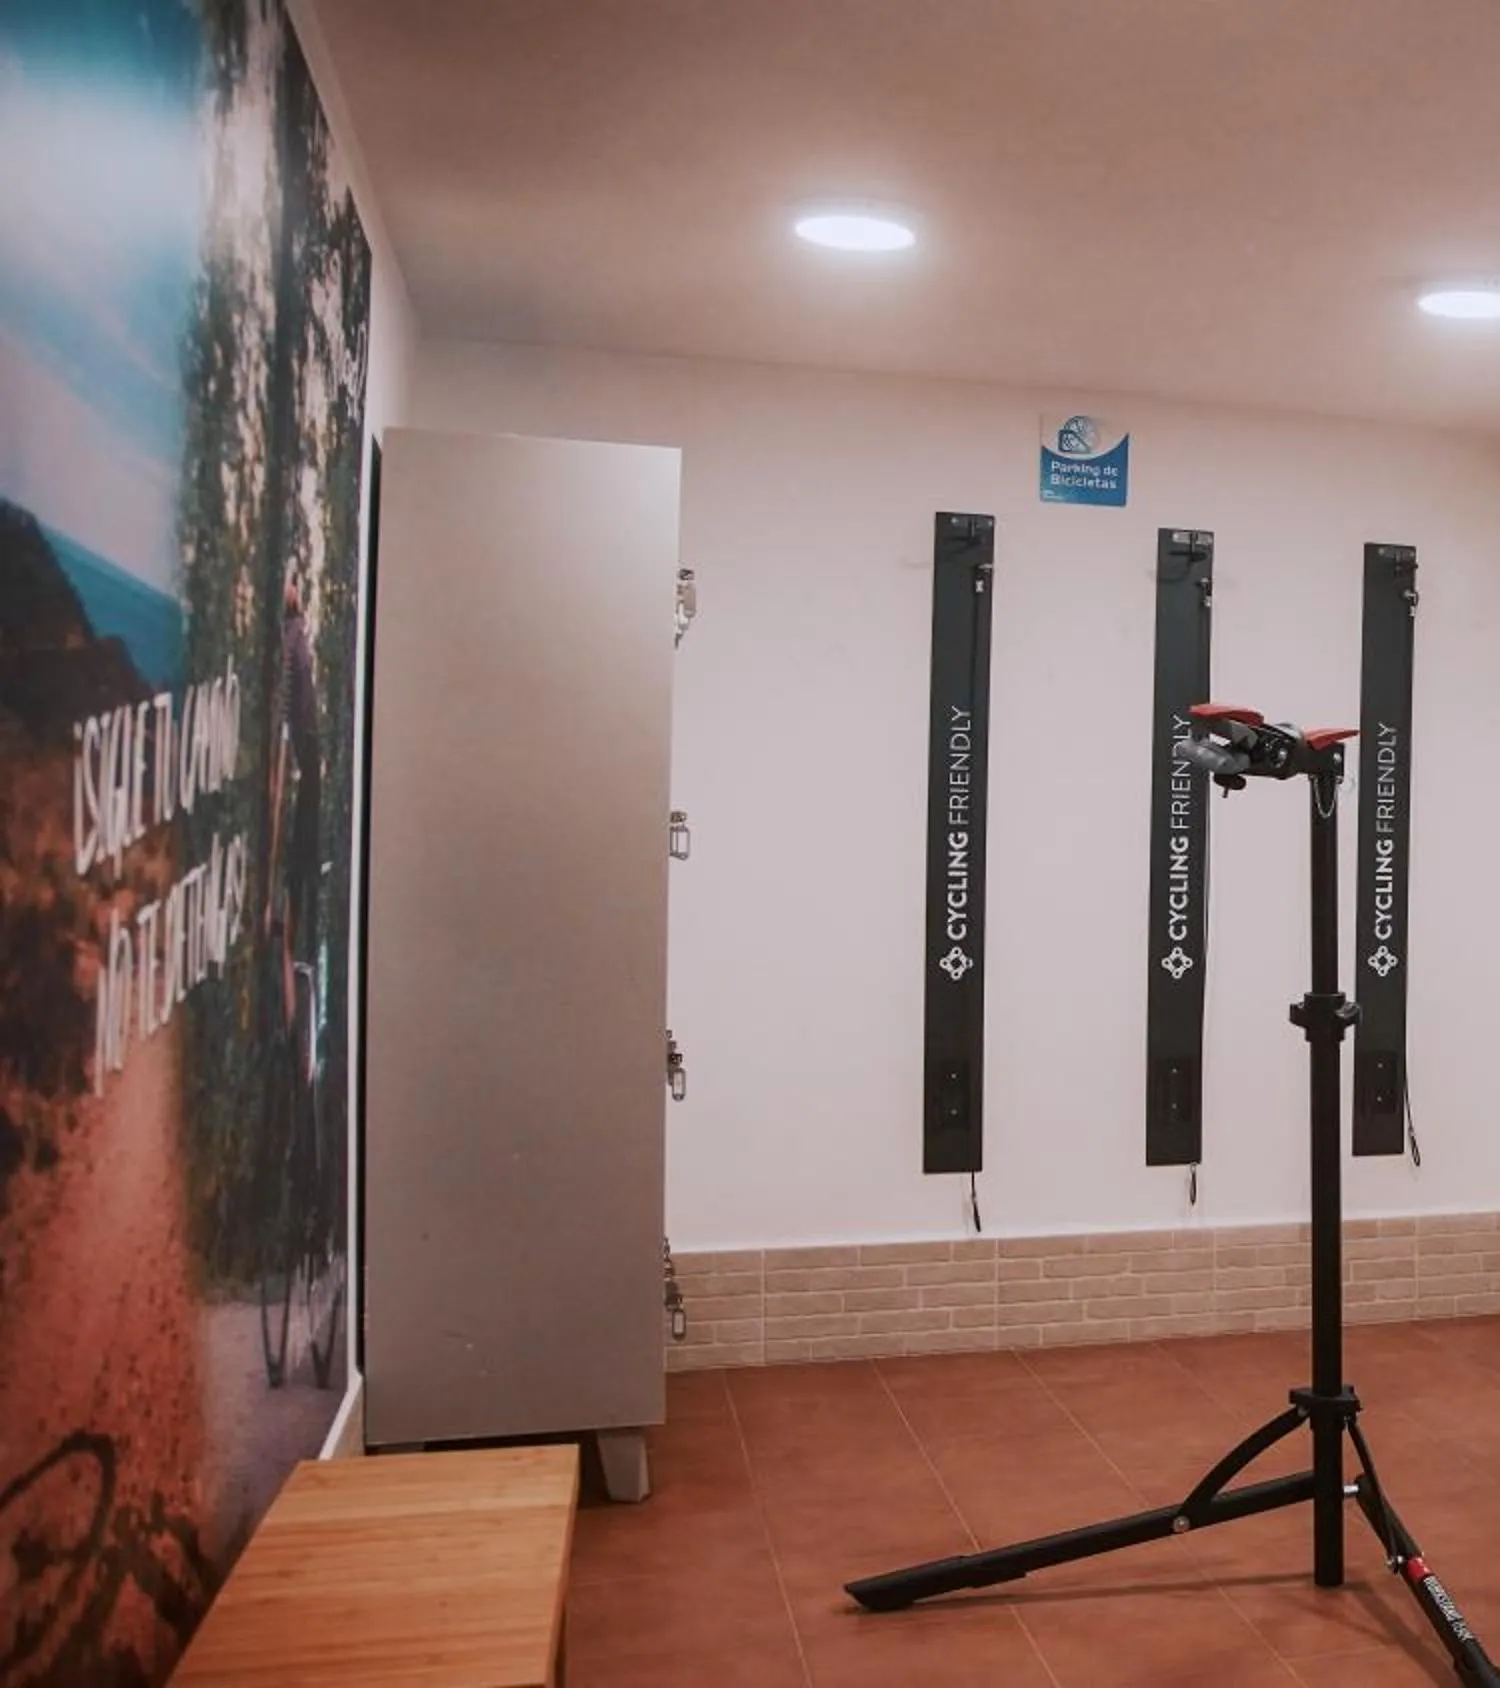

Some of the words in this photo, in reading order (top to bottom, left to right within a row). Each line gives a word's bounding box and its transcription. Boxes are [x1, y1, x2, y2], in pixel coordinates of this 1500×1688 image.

[1051, 473, 1117, 489] Bicicletas
[1052, 460, 1101, 477] Parking
[1103, 466, 1118, 477] de
[948, 705, 972, 825] FRIENDLY
[1376, 721, 1398, 833] FRIENDLY
[947, 831, 969, 941] CYCLING
[1169, 836, 1190, 941] CYCLING
[1375, 839, 1394, 941] CYCLING
